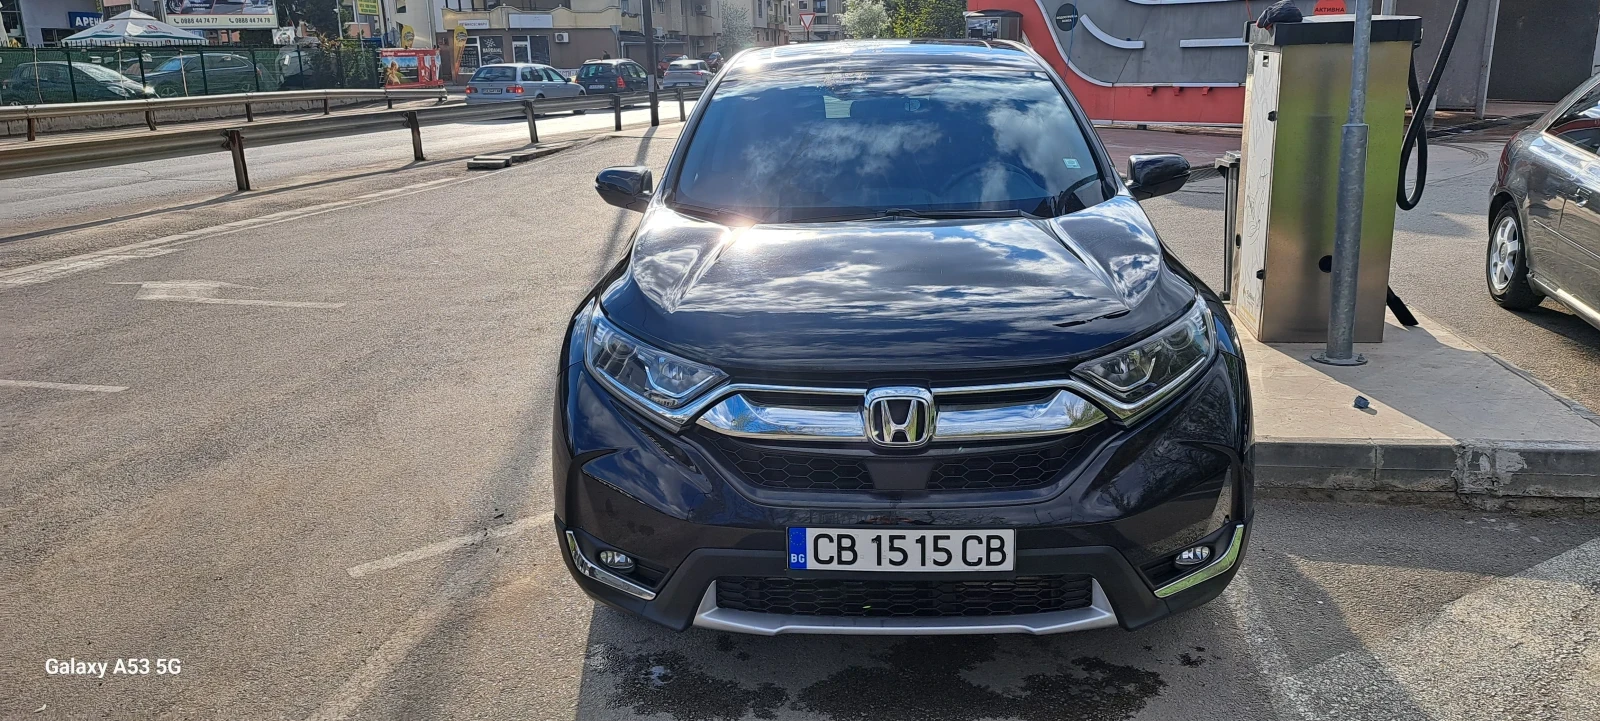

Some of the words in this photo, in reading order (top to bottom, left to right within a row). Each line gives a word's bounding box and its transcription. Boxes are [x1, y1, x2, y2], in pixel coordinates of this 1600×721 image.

[790, 553, 806, 564] BG
[813, 533, 858, 566] CB
[871, 534, 953, 567] 1515
[961, 534, 1007, 567] CB
